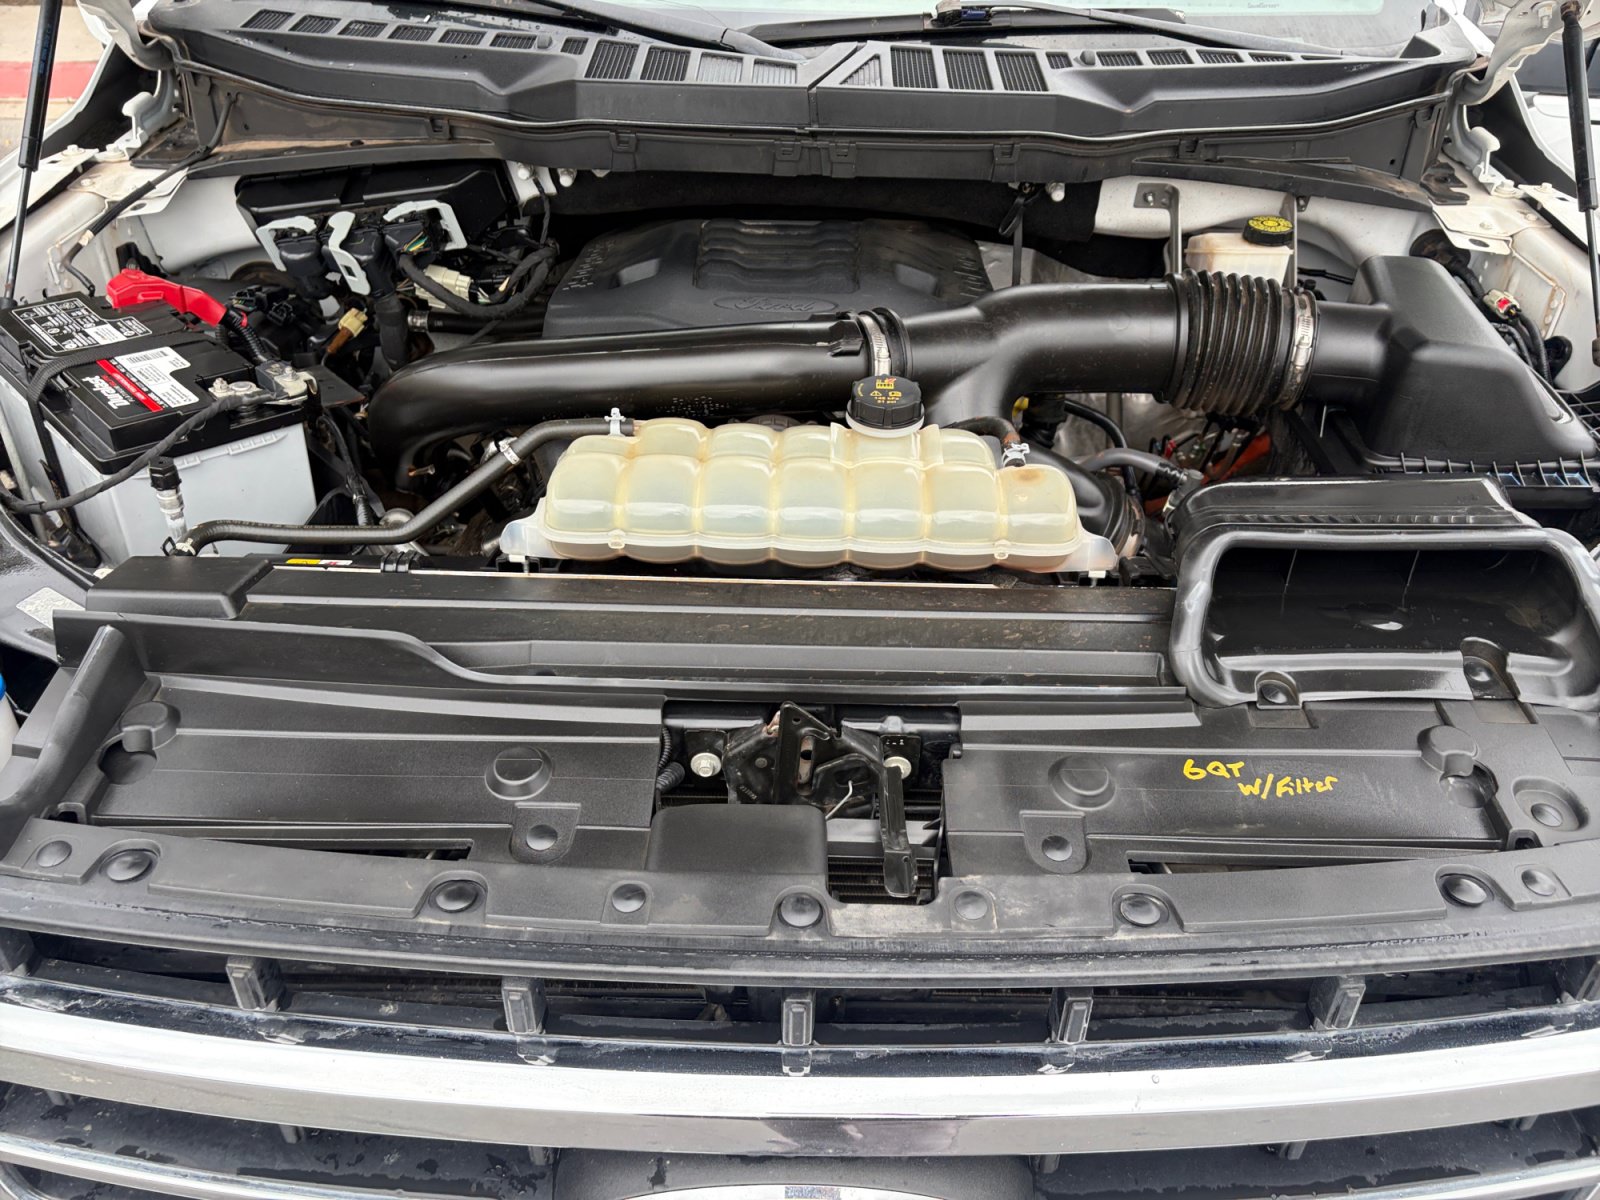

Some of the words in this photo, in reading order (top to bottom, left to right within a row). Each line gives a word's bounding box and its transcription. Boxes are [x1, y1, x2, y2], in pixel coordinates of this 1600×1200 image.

[734, 296, 817, 312] Ford
[81, 375, 131, 409] Duralast
[1183, 758, 1245, 780] 6QT
